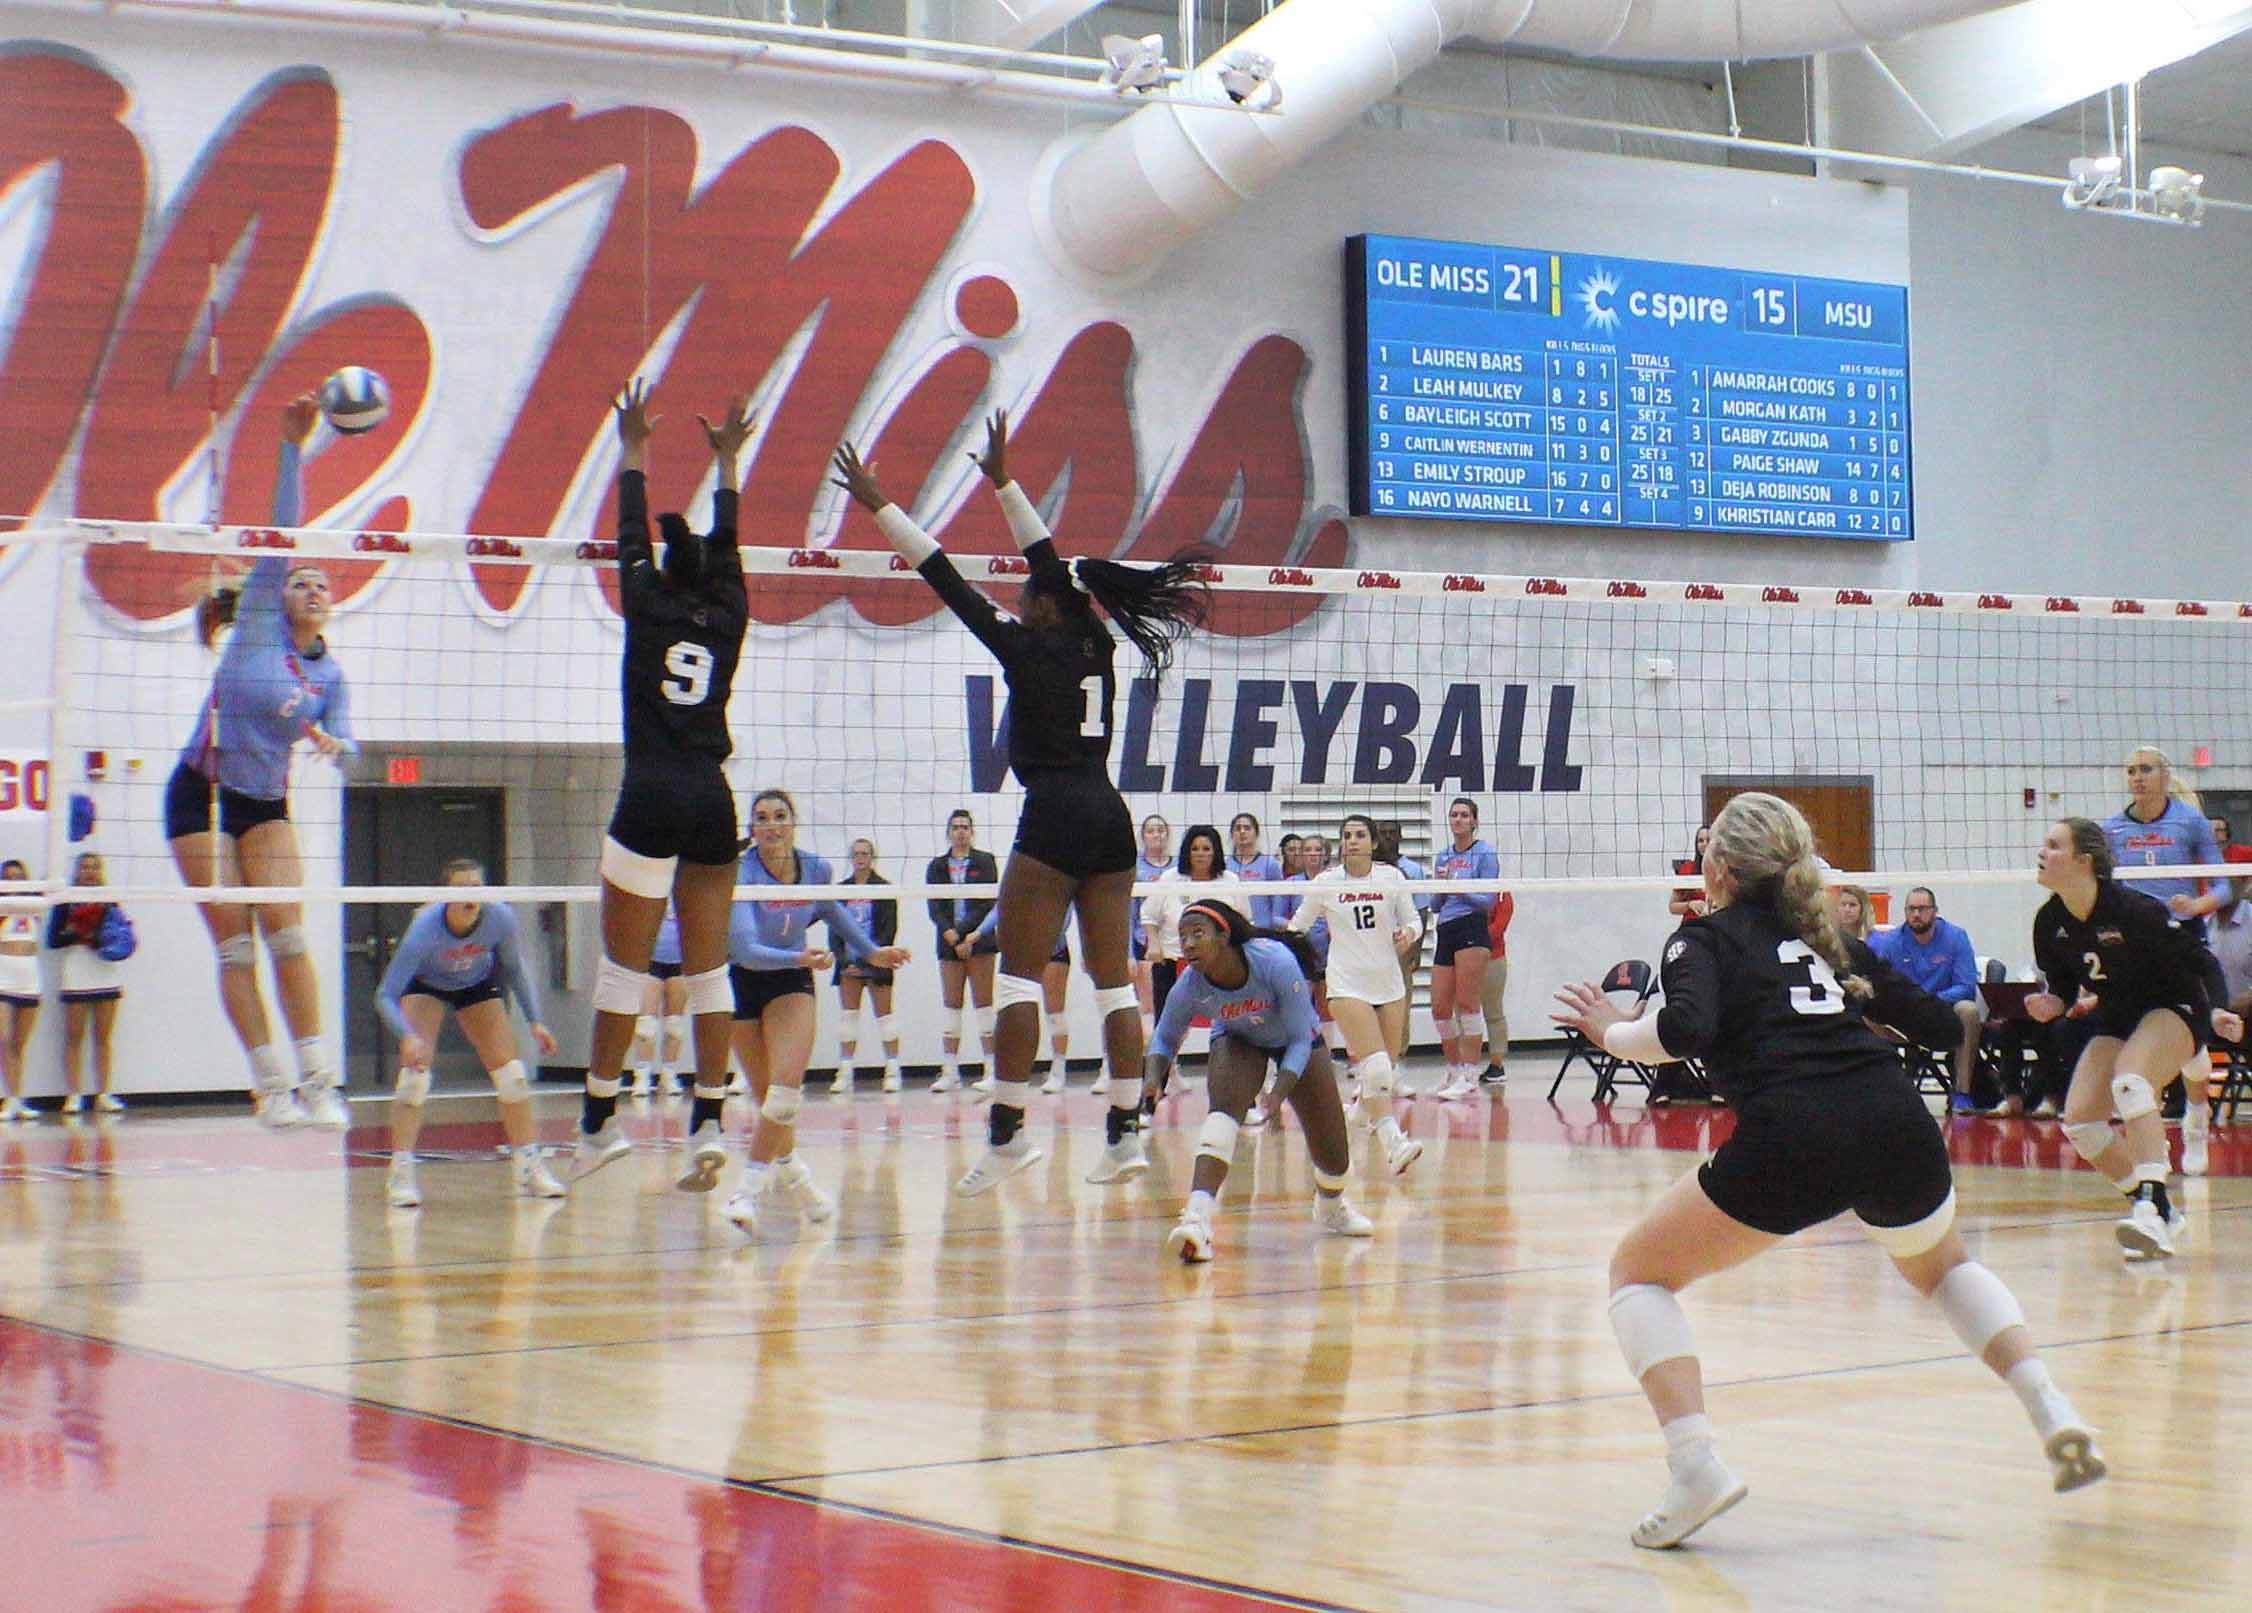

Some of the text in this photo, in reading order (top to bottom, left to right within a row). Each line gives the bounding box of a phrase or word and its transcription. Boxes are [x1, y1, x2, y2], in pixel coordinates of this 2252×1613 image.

[1377, 260, 1489, 293] OLE MISS
[1504, 264, 1538, 302] 21
[1652, 292, 1728, 328] spire
[1752, 288, 1785, 325] 15
[1825, 302, 1872, 327] MSU
[459, 103, 1351, 635] Miss
[1381, 347, 1387, 362] 1
[1412, 347, 1477, 369] LAUREN
[1482, 354, 1522, 372] BARS
[1554, 361, 1560, 375] 1
[1600, 364, 1606, 378] 1
[1631, 353, 1670, 367] TOTALS
[1380, 375, 1388, 391] 2
[1414, 378, 1454, 396] LEAH
[1459, 382, 1522, 400] MULKEY
[1578, 390, 1585, 405] 2
[1600, 391, 1608, 406] 5
[1638, 371, 1664, 383] SET 1
[1692, 370, 1698, 384] 1
[1713, 371, 1787, 393] AMARRAH
[1790, 377, 1835, 396] COOKS
[1867, 384, 1876, 398] 0
[1890, 386, 1896, 400] 1
[1630, 386, 1646, 401] 18
[1656, 388, 1671, 403] 25
[1379, 404, 1609, 433] 6 BAYLEIGH SCOTT 15 0 4
[1638, 409, 1665, 421] SET 2
[1692, 399, 1896, 427] 2 MORGAN KATH 3 2 1
[1381, 432, 1610, 461] 9 CAITLIN WERNENTIN 11 3 0
[1630, 426, 1647, 440] 25
[1657, 428, 1671, 442] 21
[1693, 426, 1898, 453] 3 GABBY ZGUNDA 1 5 0
[1639, 448, 1667, 460] SET 3
[1690, 452, 1900, 479] 12 PAIGE SHAW 14 7 4
[1377, 461, 1610, 489] 13 EMILY STROUP 16 7 0
[1631, 464, 1648, 479] 25
[1658, 466, 1673, 480] 18
[1377, 489, 1612, 515] 16 NAYO WARNELL 7 4 4
[1640, 487, 1668, 499] SET 4
[1690, 479, 1705, 494] 13
[1722, 480, 1757, 499] DEJA
[1760, 483, 1830, 501] ROBINSON
[1870, 490, 1878, 505] 0
[1893, 492, 1900, 506] 7
[1695, 506, 1900, 531] 9 KHRISTIAN CARR 12 2 0
[660, 641, 714, 705] 9
[1080, 676, 1104, 736] 1
[965, 675, 1582, 792] VLLEYBALL
[1353, 905, 1376, 930] 12
[1777, 939, 1845, 1014] 3
[2083, 952, 2107, 980] 2
